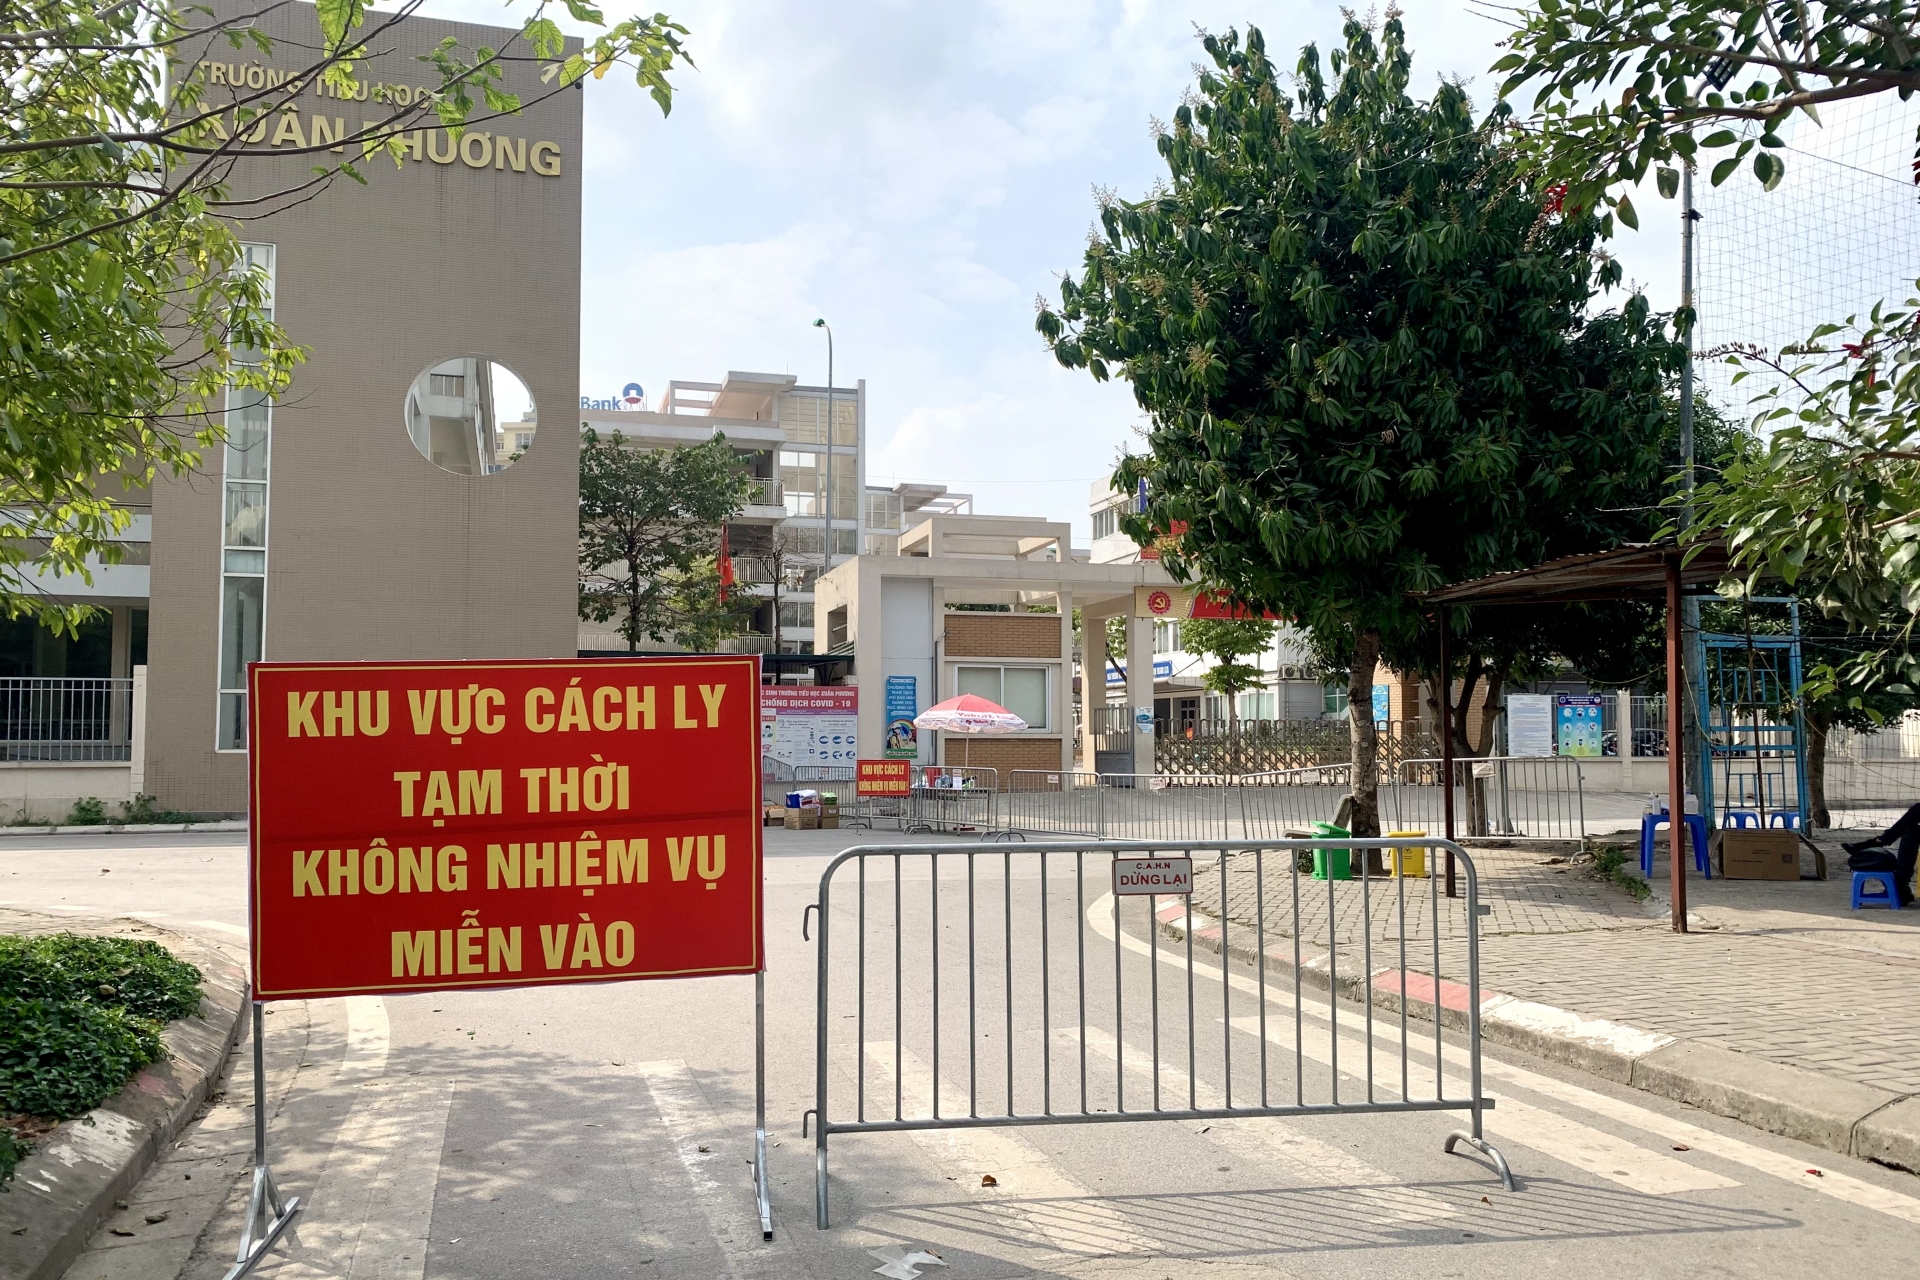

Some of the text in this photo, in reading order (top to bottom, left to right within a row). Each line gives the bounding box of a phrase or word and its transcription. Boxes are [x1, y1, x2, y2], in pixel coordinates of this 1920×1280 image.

[195, 59, 304, 94] TRƯỜNG
[286, 677, 727, 745] KHU VỰC CÁCH LY
[393, 753, 630, 827] TẠM THỜI
[861, 764, 872, 775] KHU
[291, 830, 726, 897] KHÔNG NHIỆM VỤ
[1120, 871, 1187, 887] DỪNG LẠI
[1136, 862, 1171, 870] C.A.H.N
[390, 909, 635, 978] MIỄN VÀO
